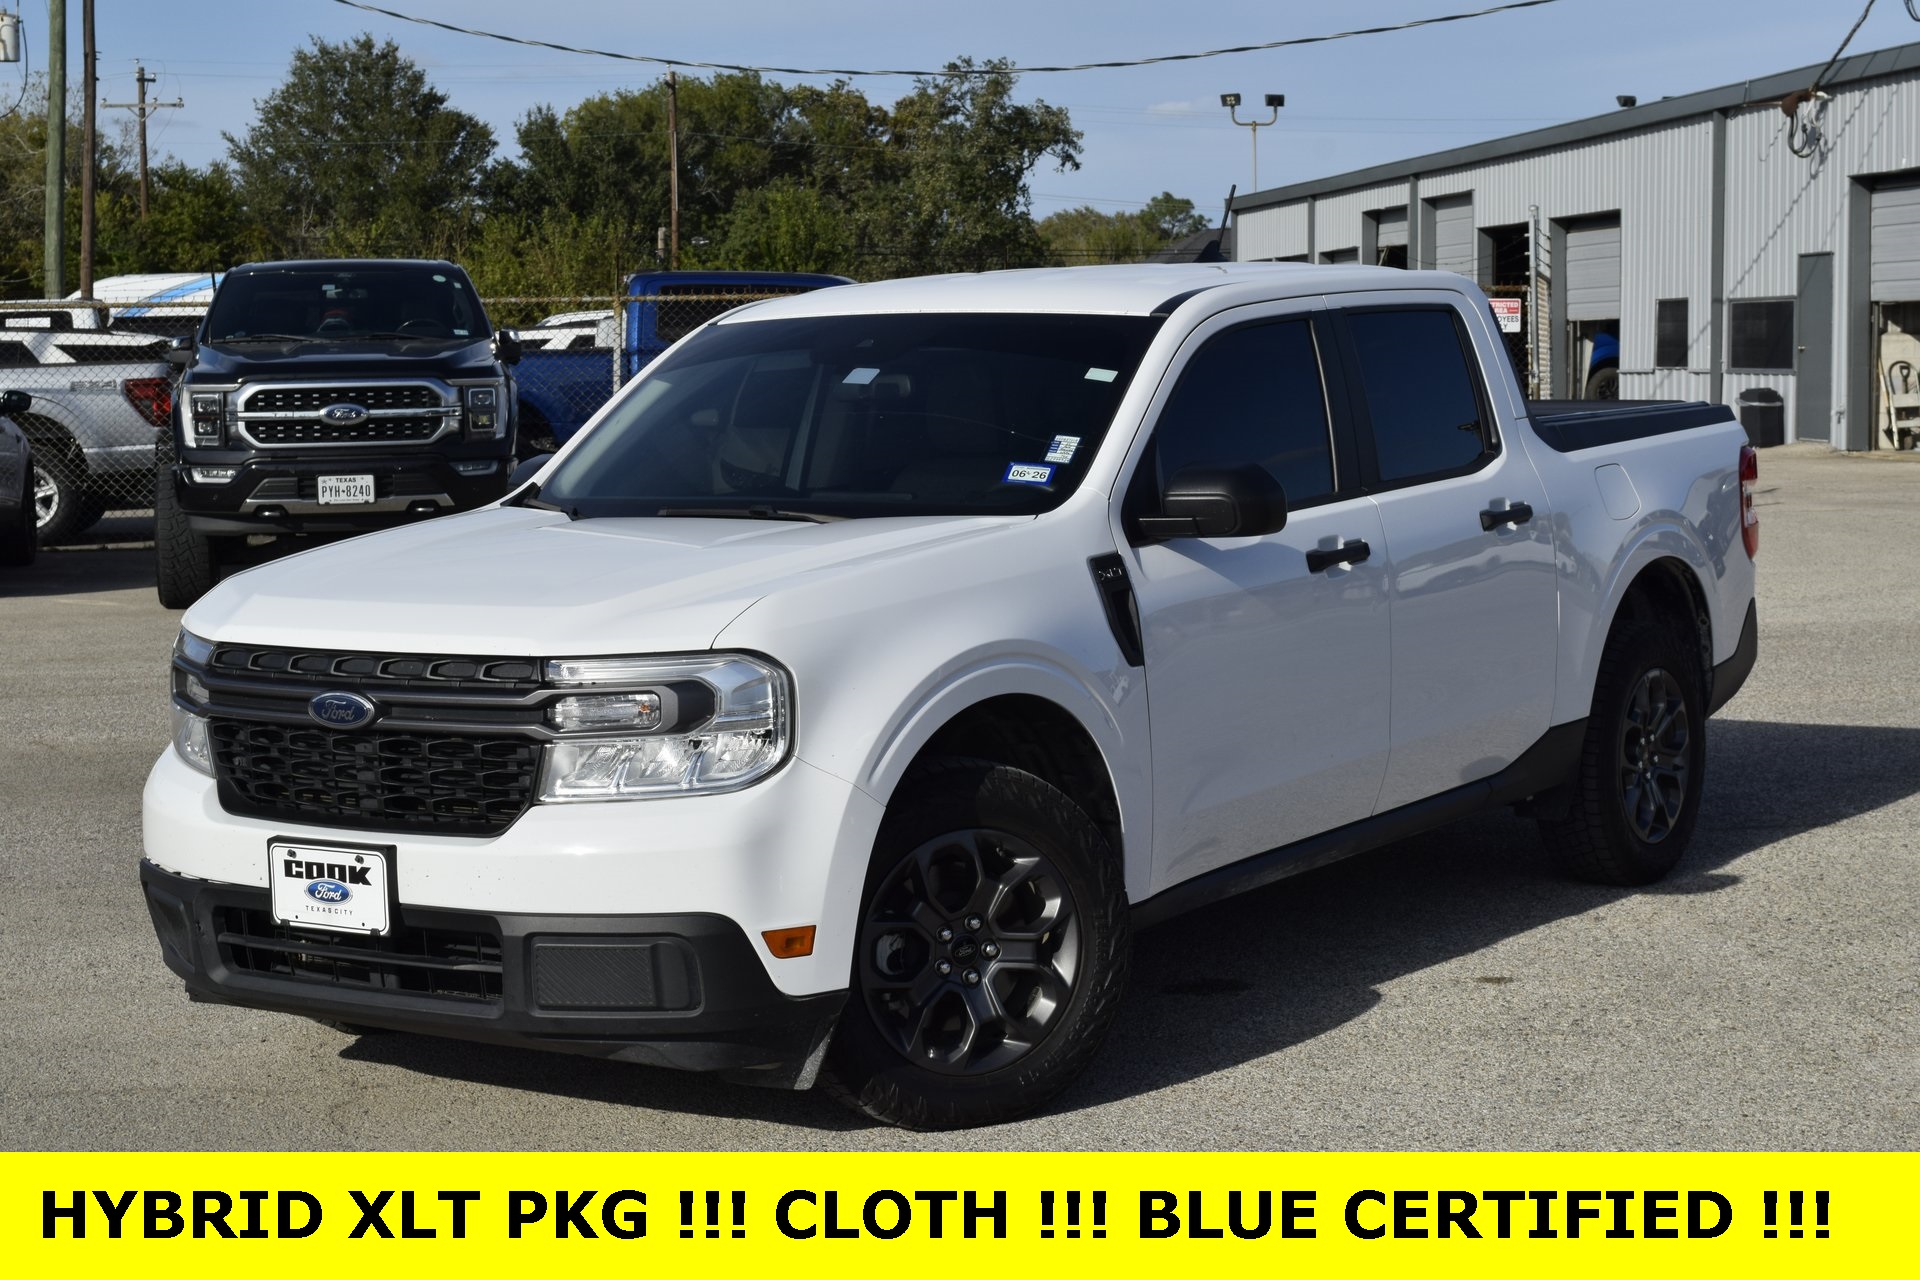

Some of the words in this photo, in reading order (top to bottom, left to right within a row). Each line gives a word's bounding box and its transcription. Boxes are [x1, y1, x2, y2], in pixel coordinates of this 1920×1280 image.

[321, 699, 356, 720] Ford
[283, 859, 372, 886] COOK
[314, 882, 342, 901] Ford
